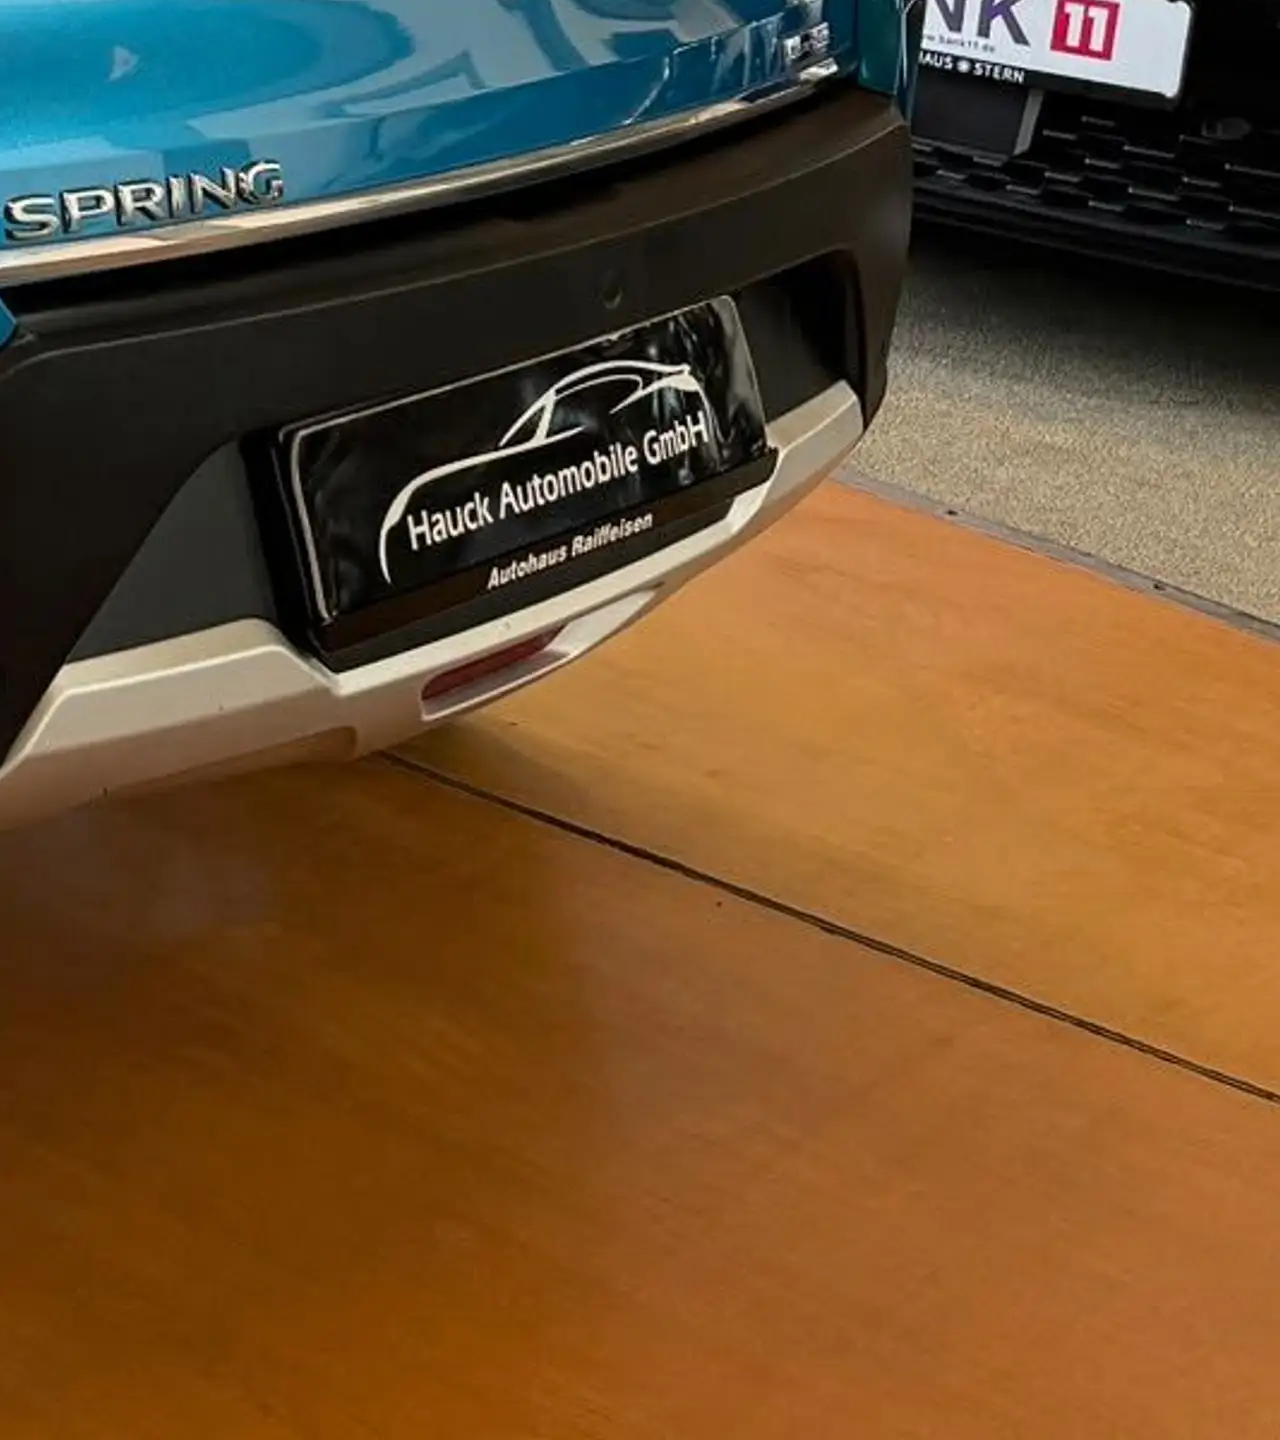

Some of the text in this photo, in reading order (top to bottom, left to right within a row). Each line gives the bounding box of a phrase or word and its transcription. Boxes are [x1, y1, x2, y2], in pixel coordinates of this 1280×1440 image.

[973, 62, 1025, 83] STERN
[3, 161, 286, 243] SPRING
[407, 410, 709, 551] Hauck Automobile GmbH
[487, 510, 654, 590] Autohaus Raiffeisen
